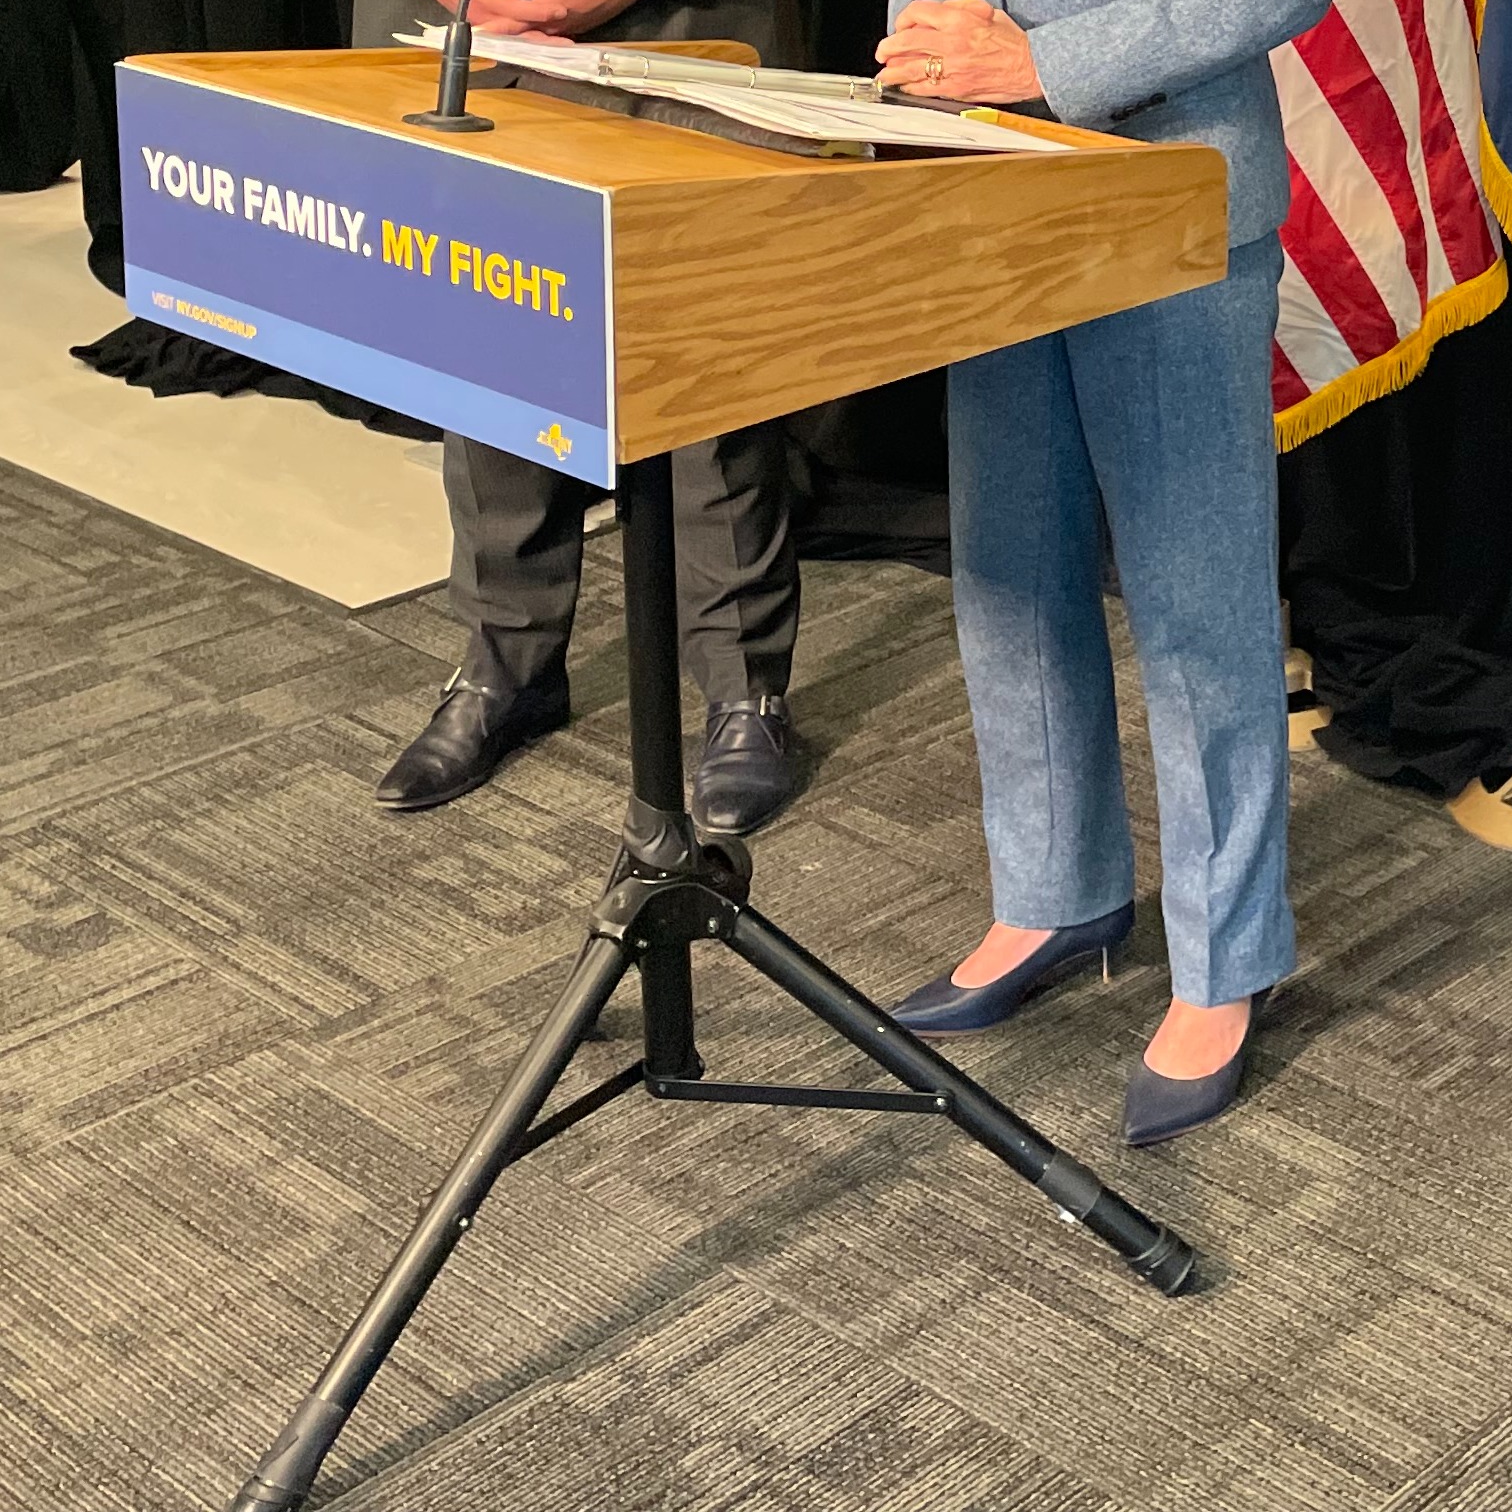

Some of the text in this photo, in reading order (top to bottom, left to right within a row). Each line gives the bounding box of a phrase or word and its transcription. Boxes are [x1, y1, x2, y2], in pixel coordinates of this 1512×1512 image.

[141, 146, 574, 322] YOUR FAMILY. MY FIGHT.
